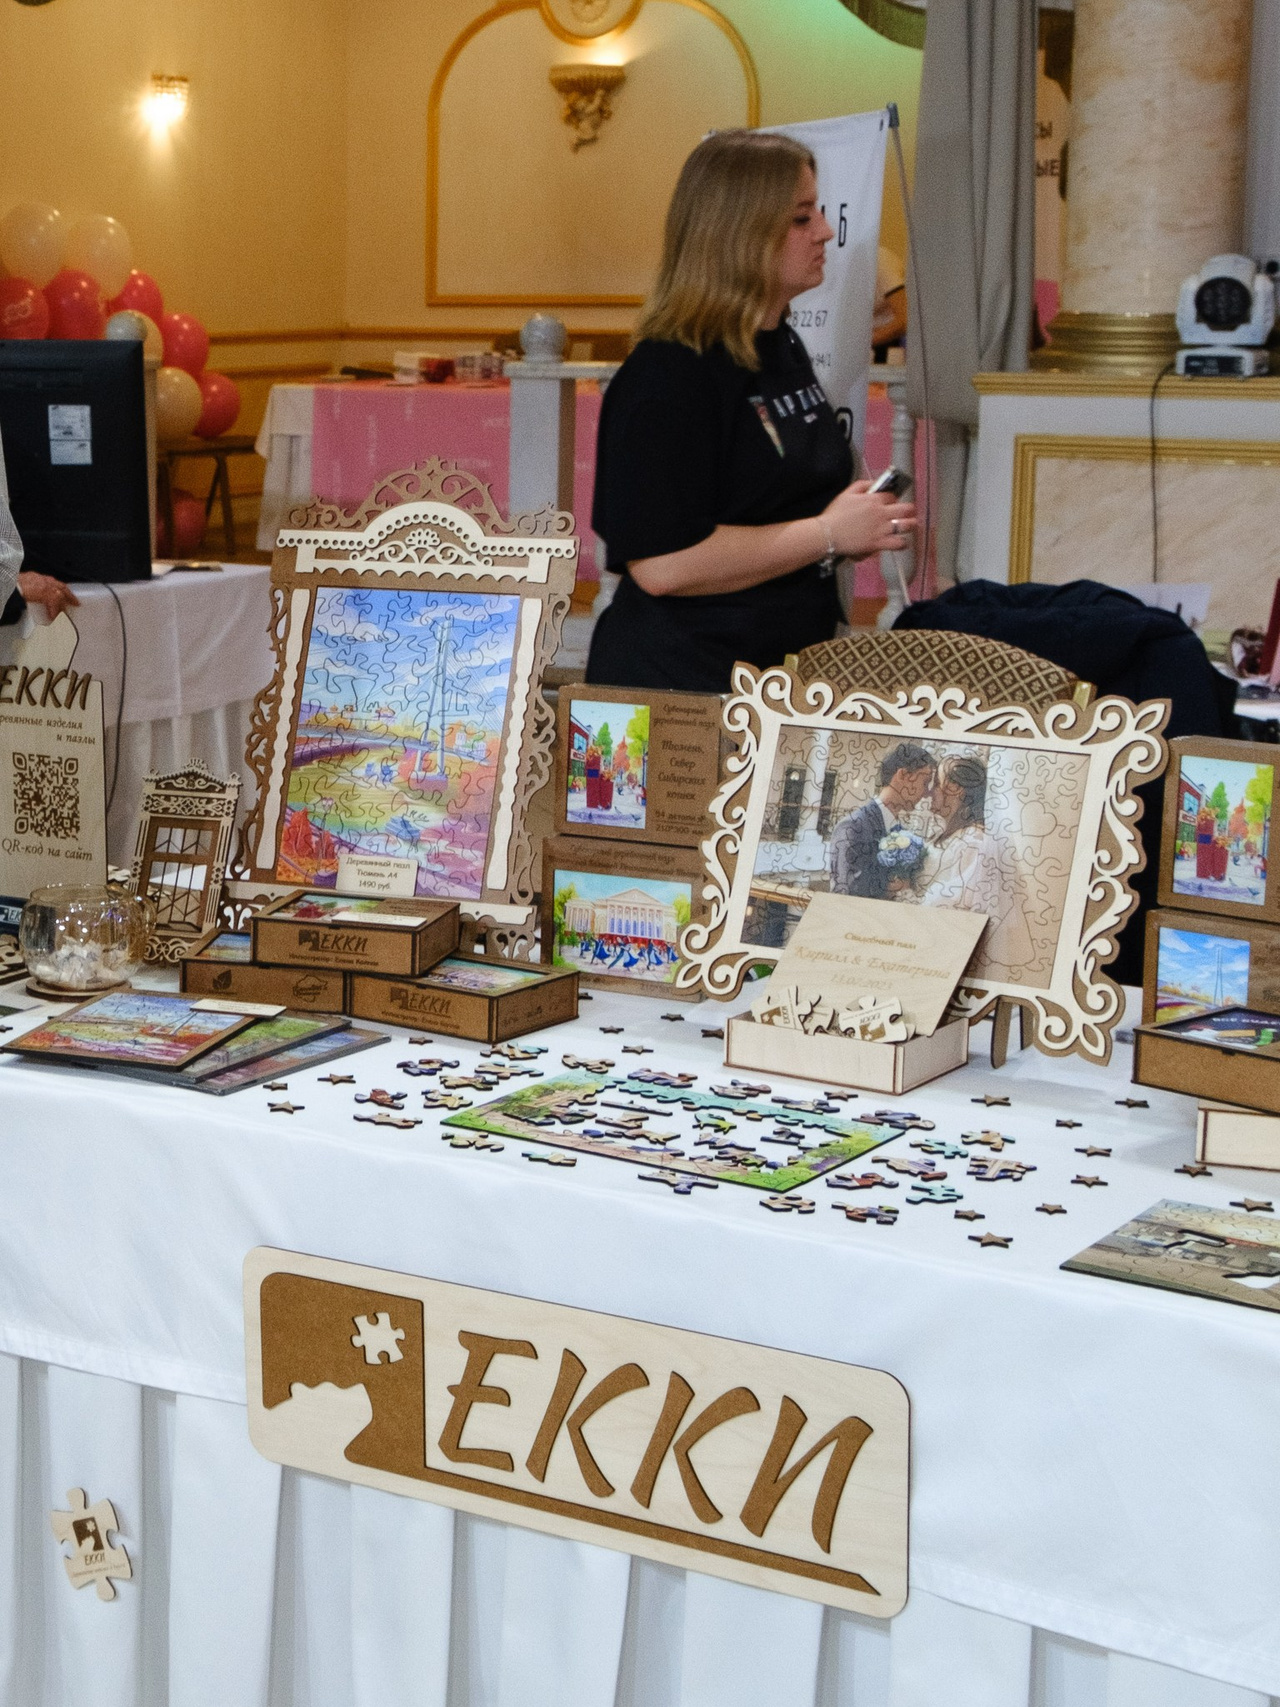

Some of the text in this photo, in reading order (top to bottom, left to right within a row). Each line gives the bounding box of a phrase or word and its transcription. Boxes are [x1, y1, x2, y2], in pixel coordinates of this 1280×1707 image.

[46, 717, 83, 730] изделия
[56, 734, 96, 745] и пазлы
[1, 838, 93, 861] QR-код на сайт
[346, 857, 392, 868] Деревянный
[357, 869, 386, 878] Тюмень
[358, 880, 376, 888] 1490
[320, 933, 369, 953] ЕККИ
[867, 956, 951, 981] Екатерина
[409, 993, 452, 1015] ЕККИ
[437, 1329, 874, 1555] ЕККИ
[84, 1551, 105, 1566] ЕККИ
